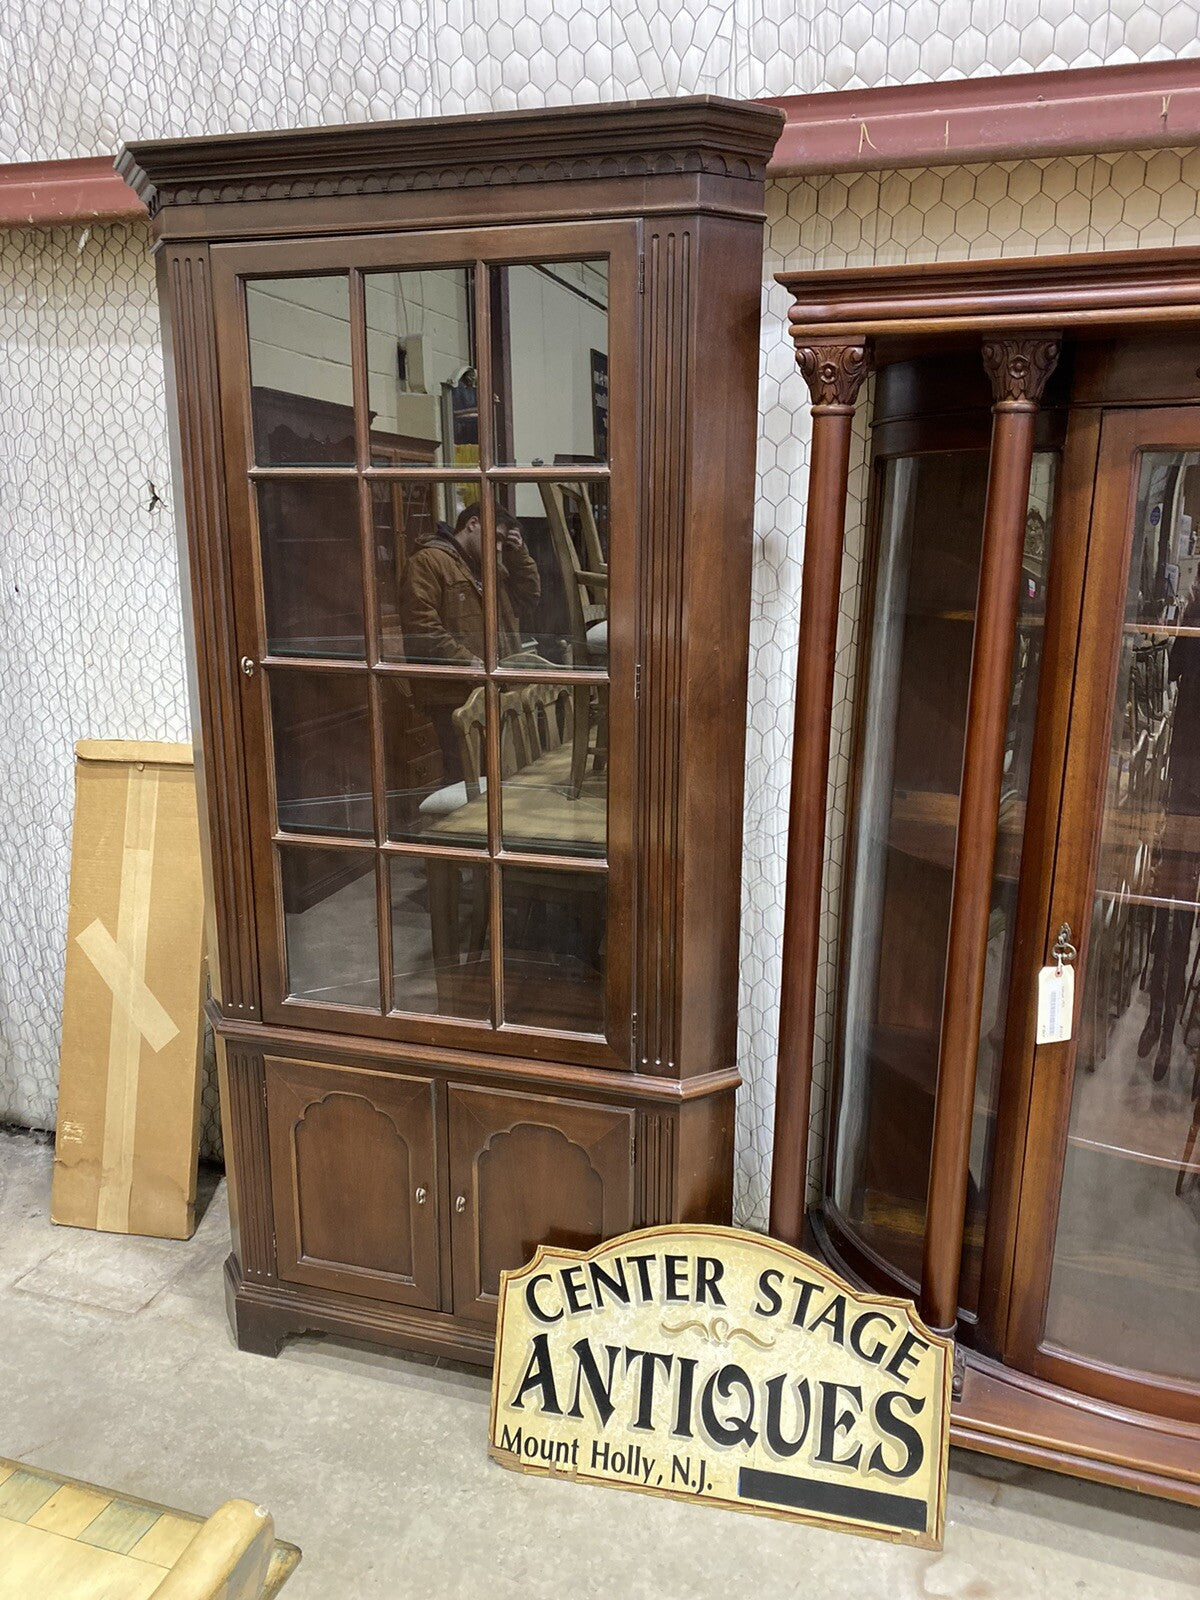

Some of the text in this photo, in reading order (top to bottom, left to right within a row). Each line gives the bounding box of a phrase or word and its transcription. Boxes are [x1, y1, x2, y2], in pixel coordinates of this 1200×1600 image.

[526, 1254, 930, 1383] CENTER STAGE
[500, 1424, 714, 1494] Mount Holly, N.J.
[510, 1332, 927, 1478] ANTIQUES
